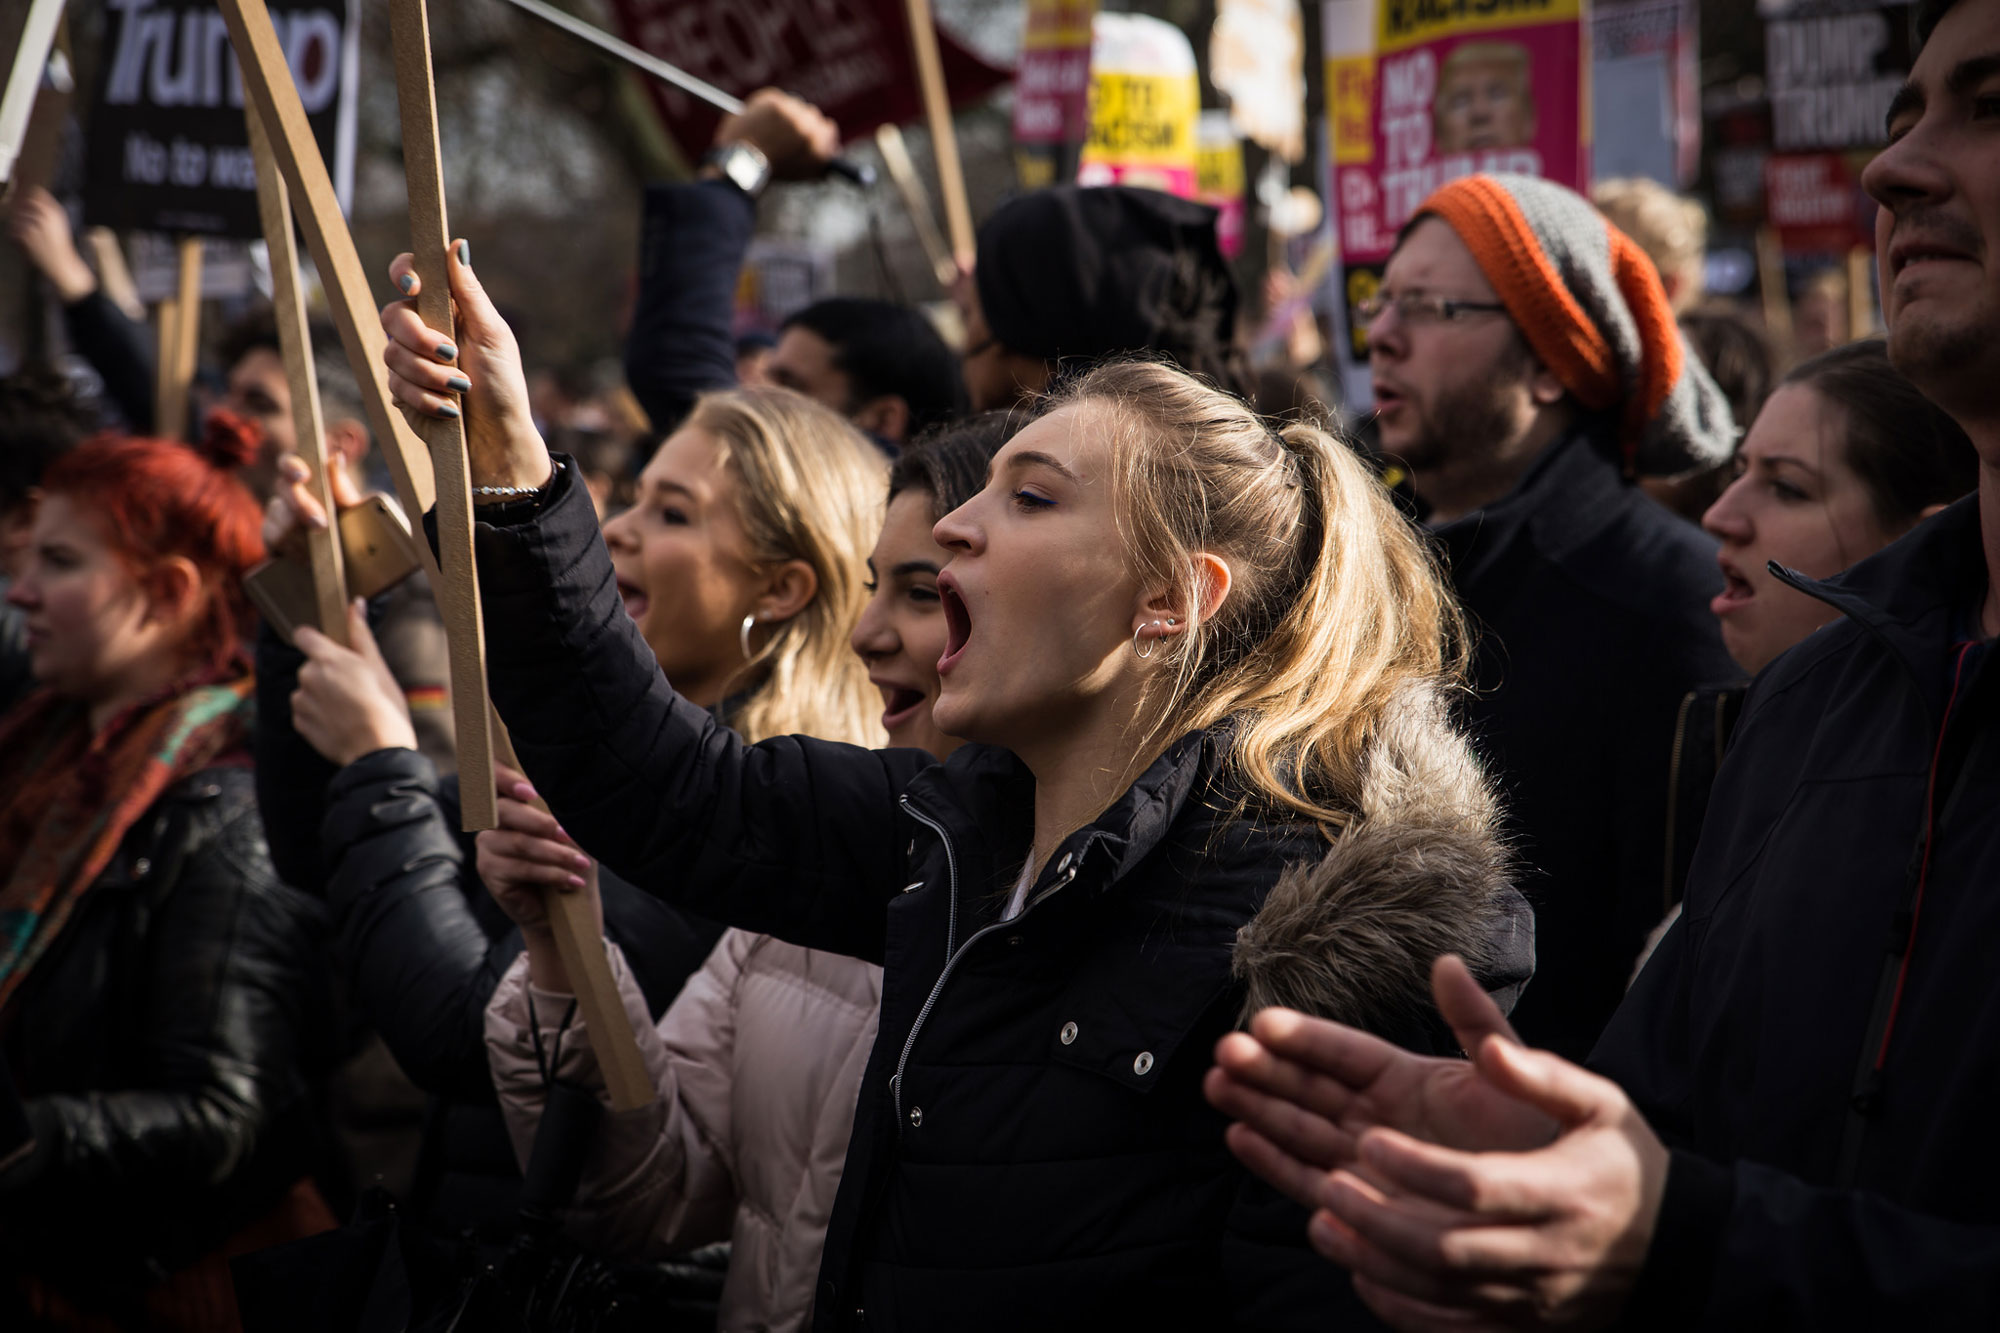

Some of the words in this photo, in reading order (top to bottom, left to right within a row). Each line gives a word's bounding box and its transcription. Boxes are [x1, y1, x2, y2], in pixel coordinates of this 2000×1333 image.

[1386, 0, 1552, 38] RAC
[1382, 48, 1436, 106] NO
[1768, 14, 1888, 84] DUMP
[126, 134, 167, 184] No
[171, 138, 206, 187] to
[212, 147, 257, 190] wa
[1380, 110, 1432, 166] TO
[1382, 152, 1543, 226] TRP
